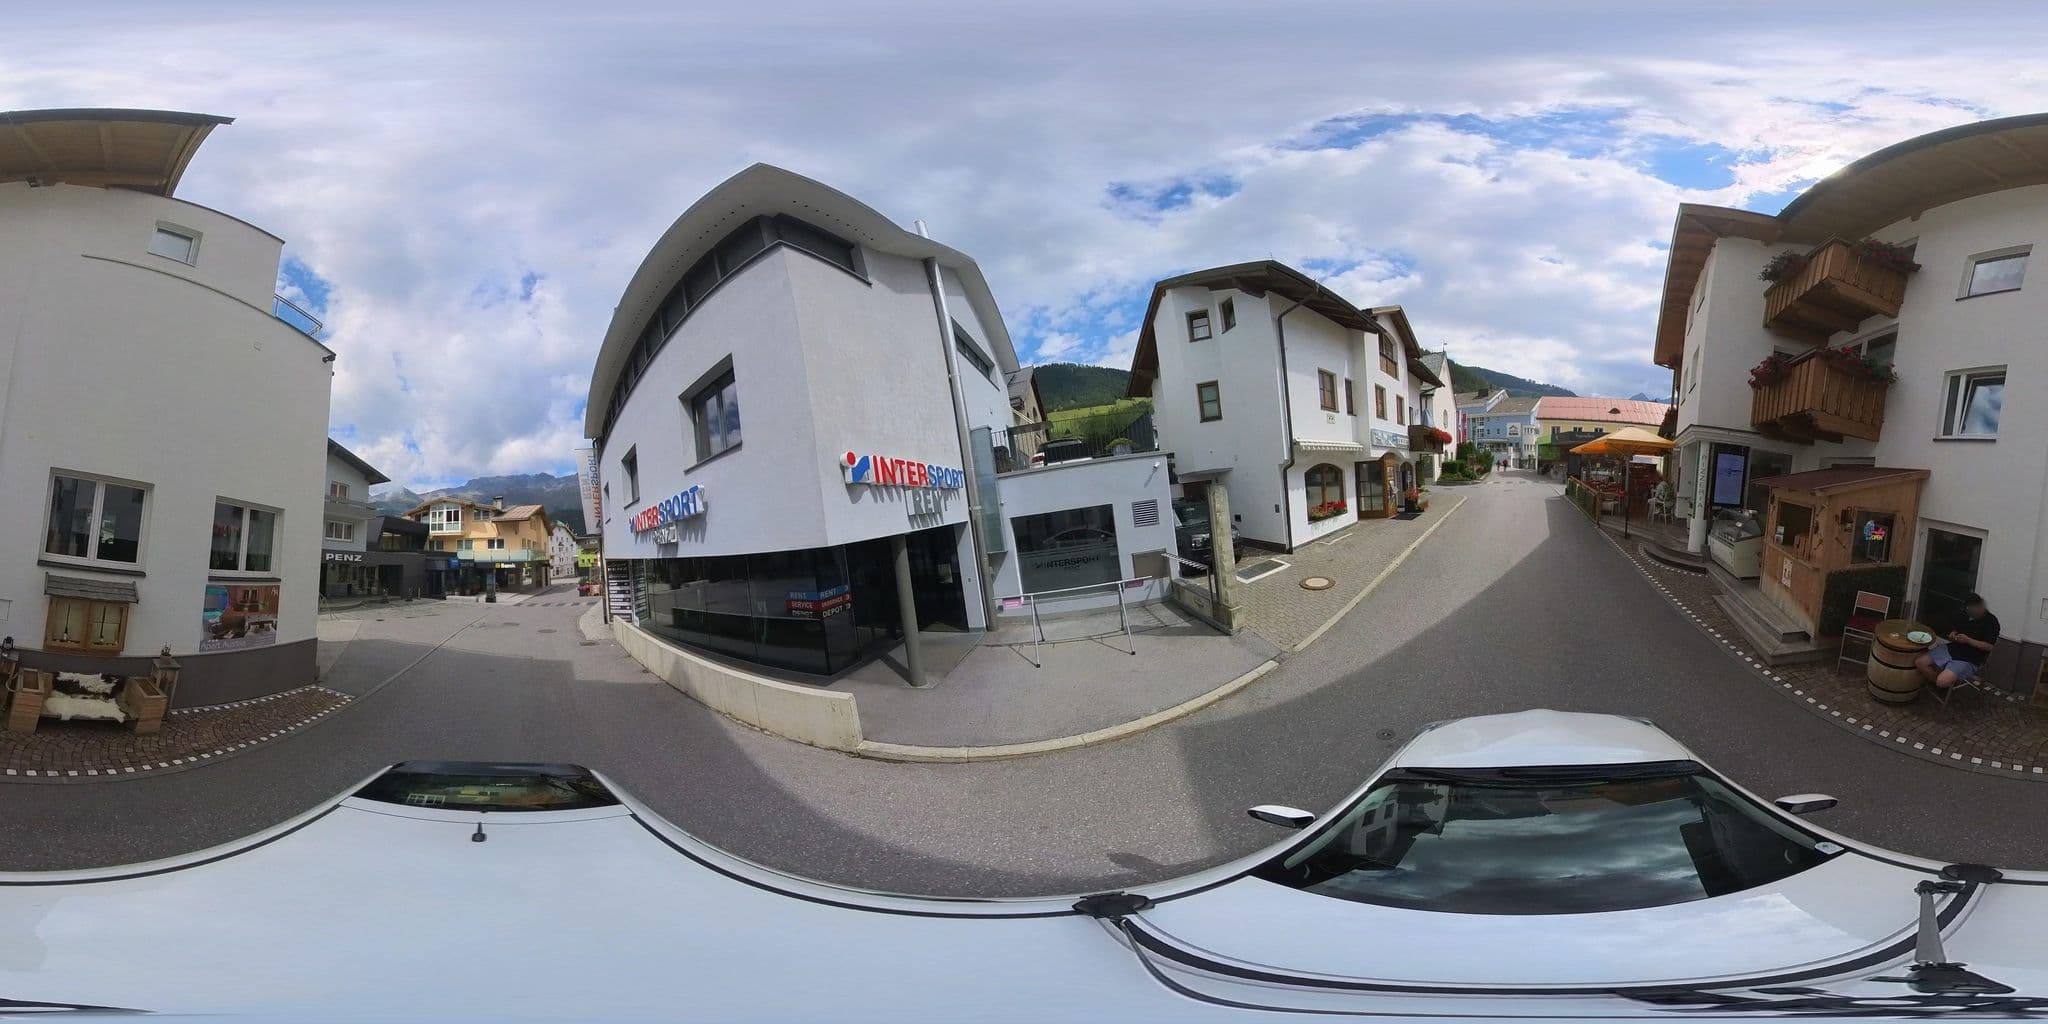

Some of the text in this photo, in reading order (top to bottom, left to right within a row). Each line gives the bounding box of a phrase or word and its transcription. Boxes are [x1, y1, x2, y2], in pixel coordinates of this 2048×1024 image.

[872, 455, 963, 488] INTERSPORT
[636, 485, 702, 533] INTERSPORT
[907, 487, 948, 514] RENT
[326, 553, 362, 561] PENZ
[822, 605, 843, 618] DEPOT
